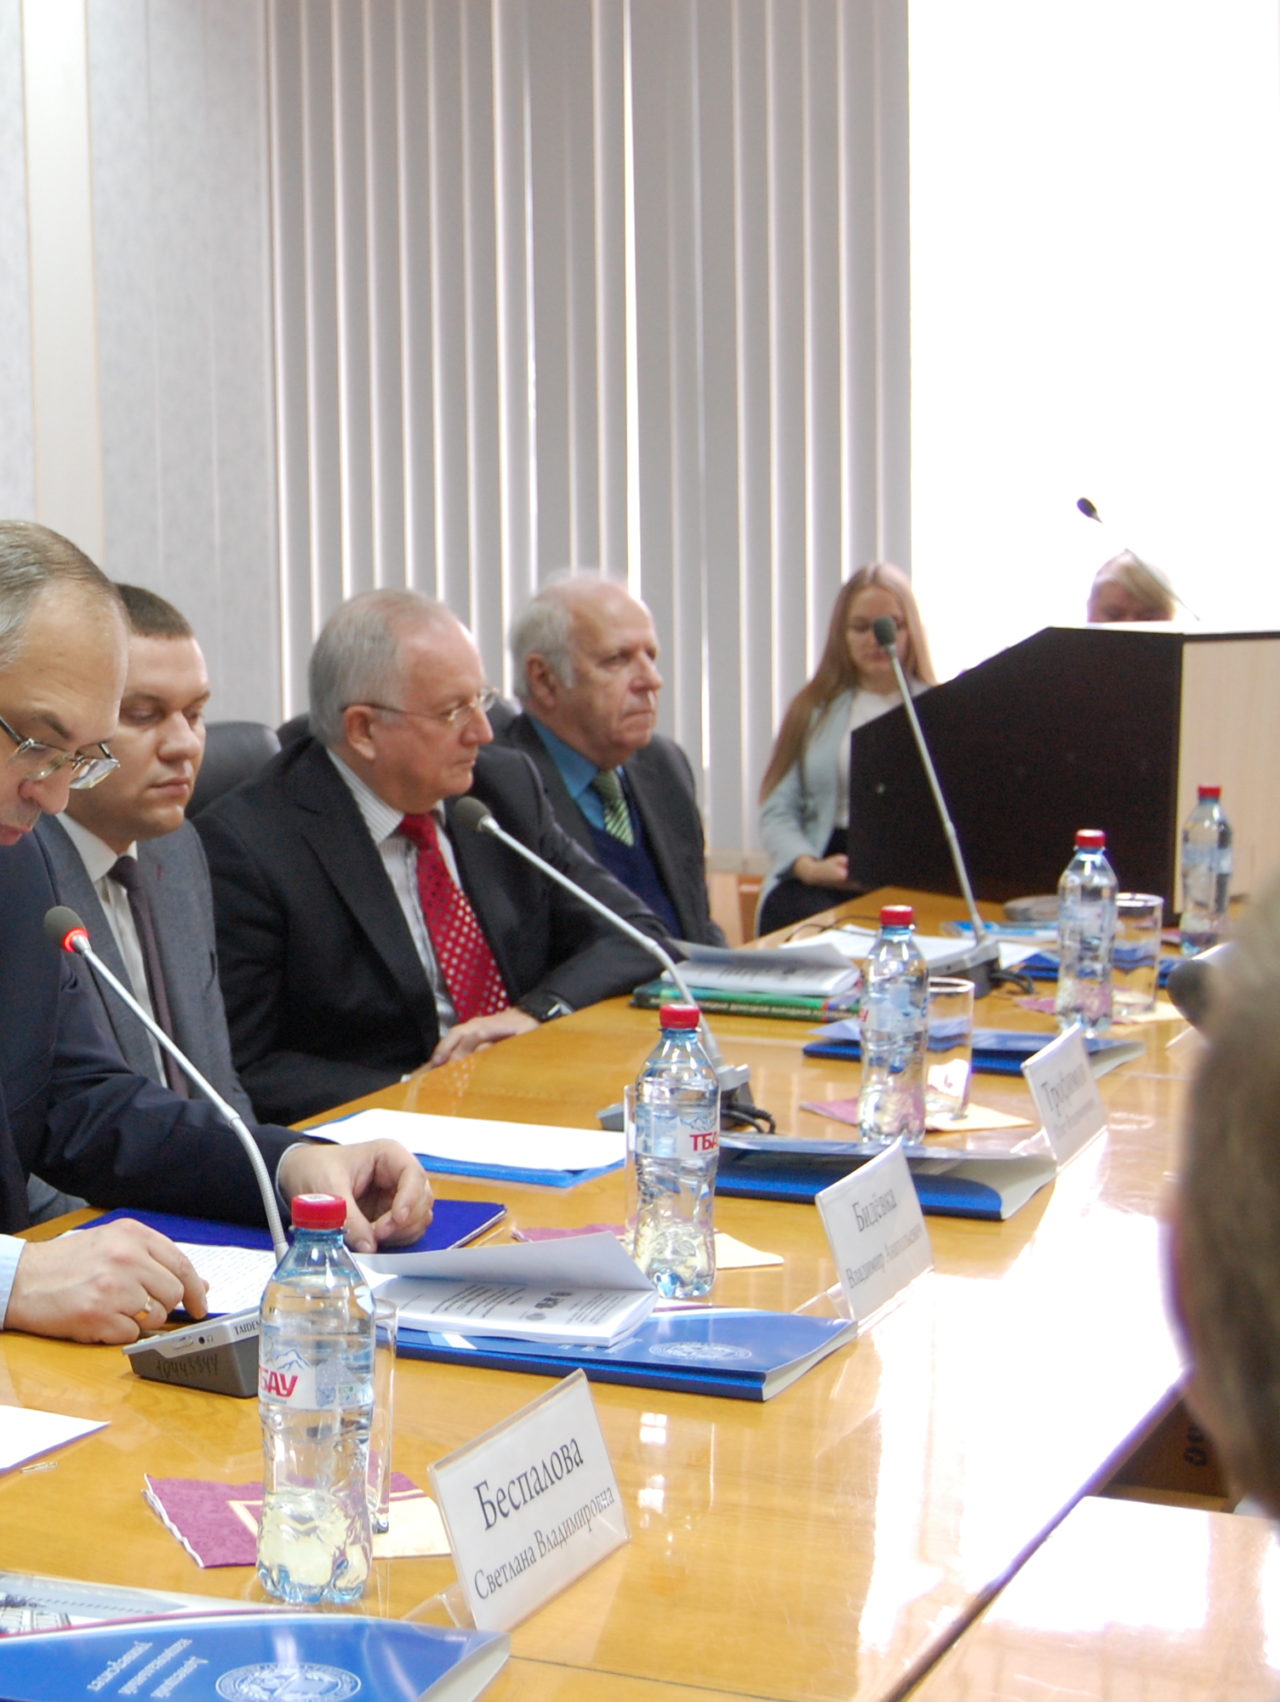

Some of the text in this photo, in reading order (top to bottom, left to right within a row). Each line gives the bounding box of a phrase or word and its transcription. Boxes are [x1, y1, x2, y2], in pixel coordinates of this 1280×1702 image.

[473, 1437, 584, 1531] Беспалова
[474, 1487, 615, 1600] Светлана Владимировна
